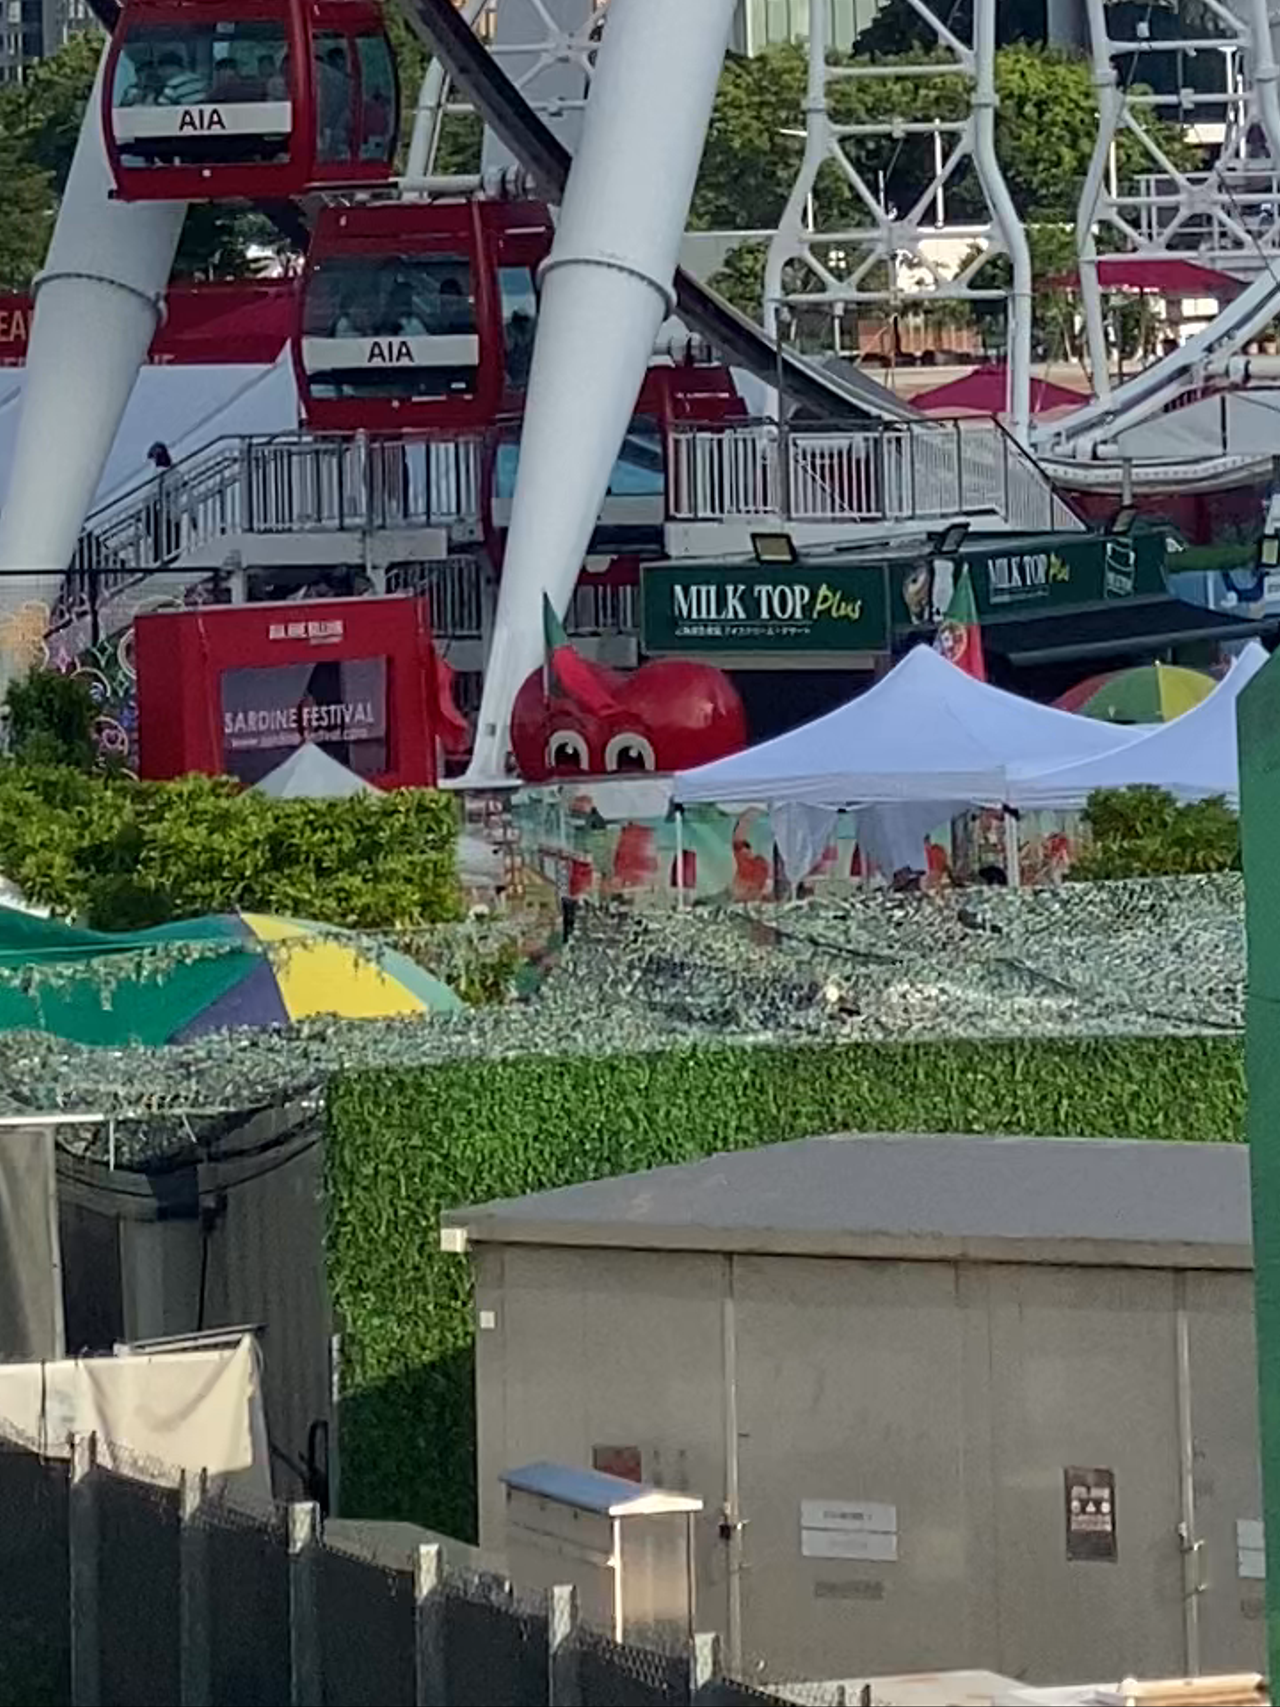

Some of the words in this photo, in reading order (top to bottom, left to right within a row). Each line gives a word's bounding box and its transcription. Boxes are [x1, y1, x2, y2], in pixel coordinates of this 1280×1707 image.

[178, 107, 226, 132] AIA
[367, 339, 416, 364] AIA
[673, 584, 747, 620] MILK
[753, 584, 811, 620] TOP
[812, 583, 862, 620] Plus
[224, 707, 299, 734] SARDINE
[302, 701, 375, 728] FESTIVAL
